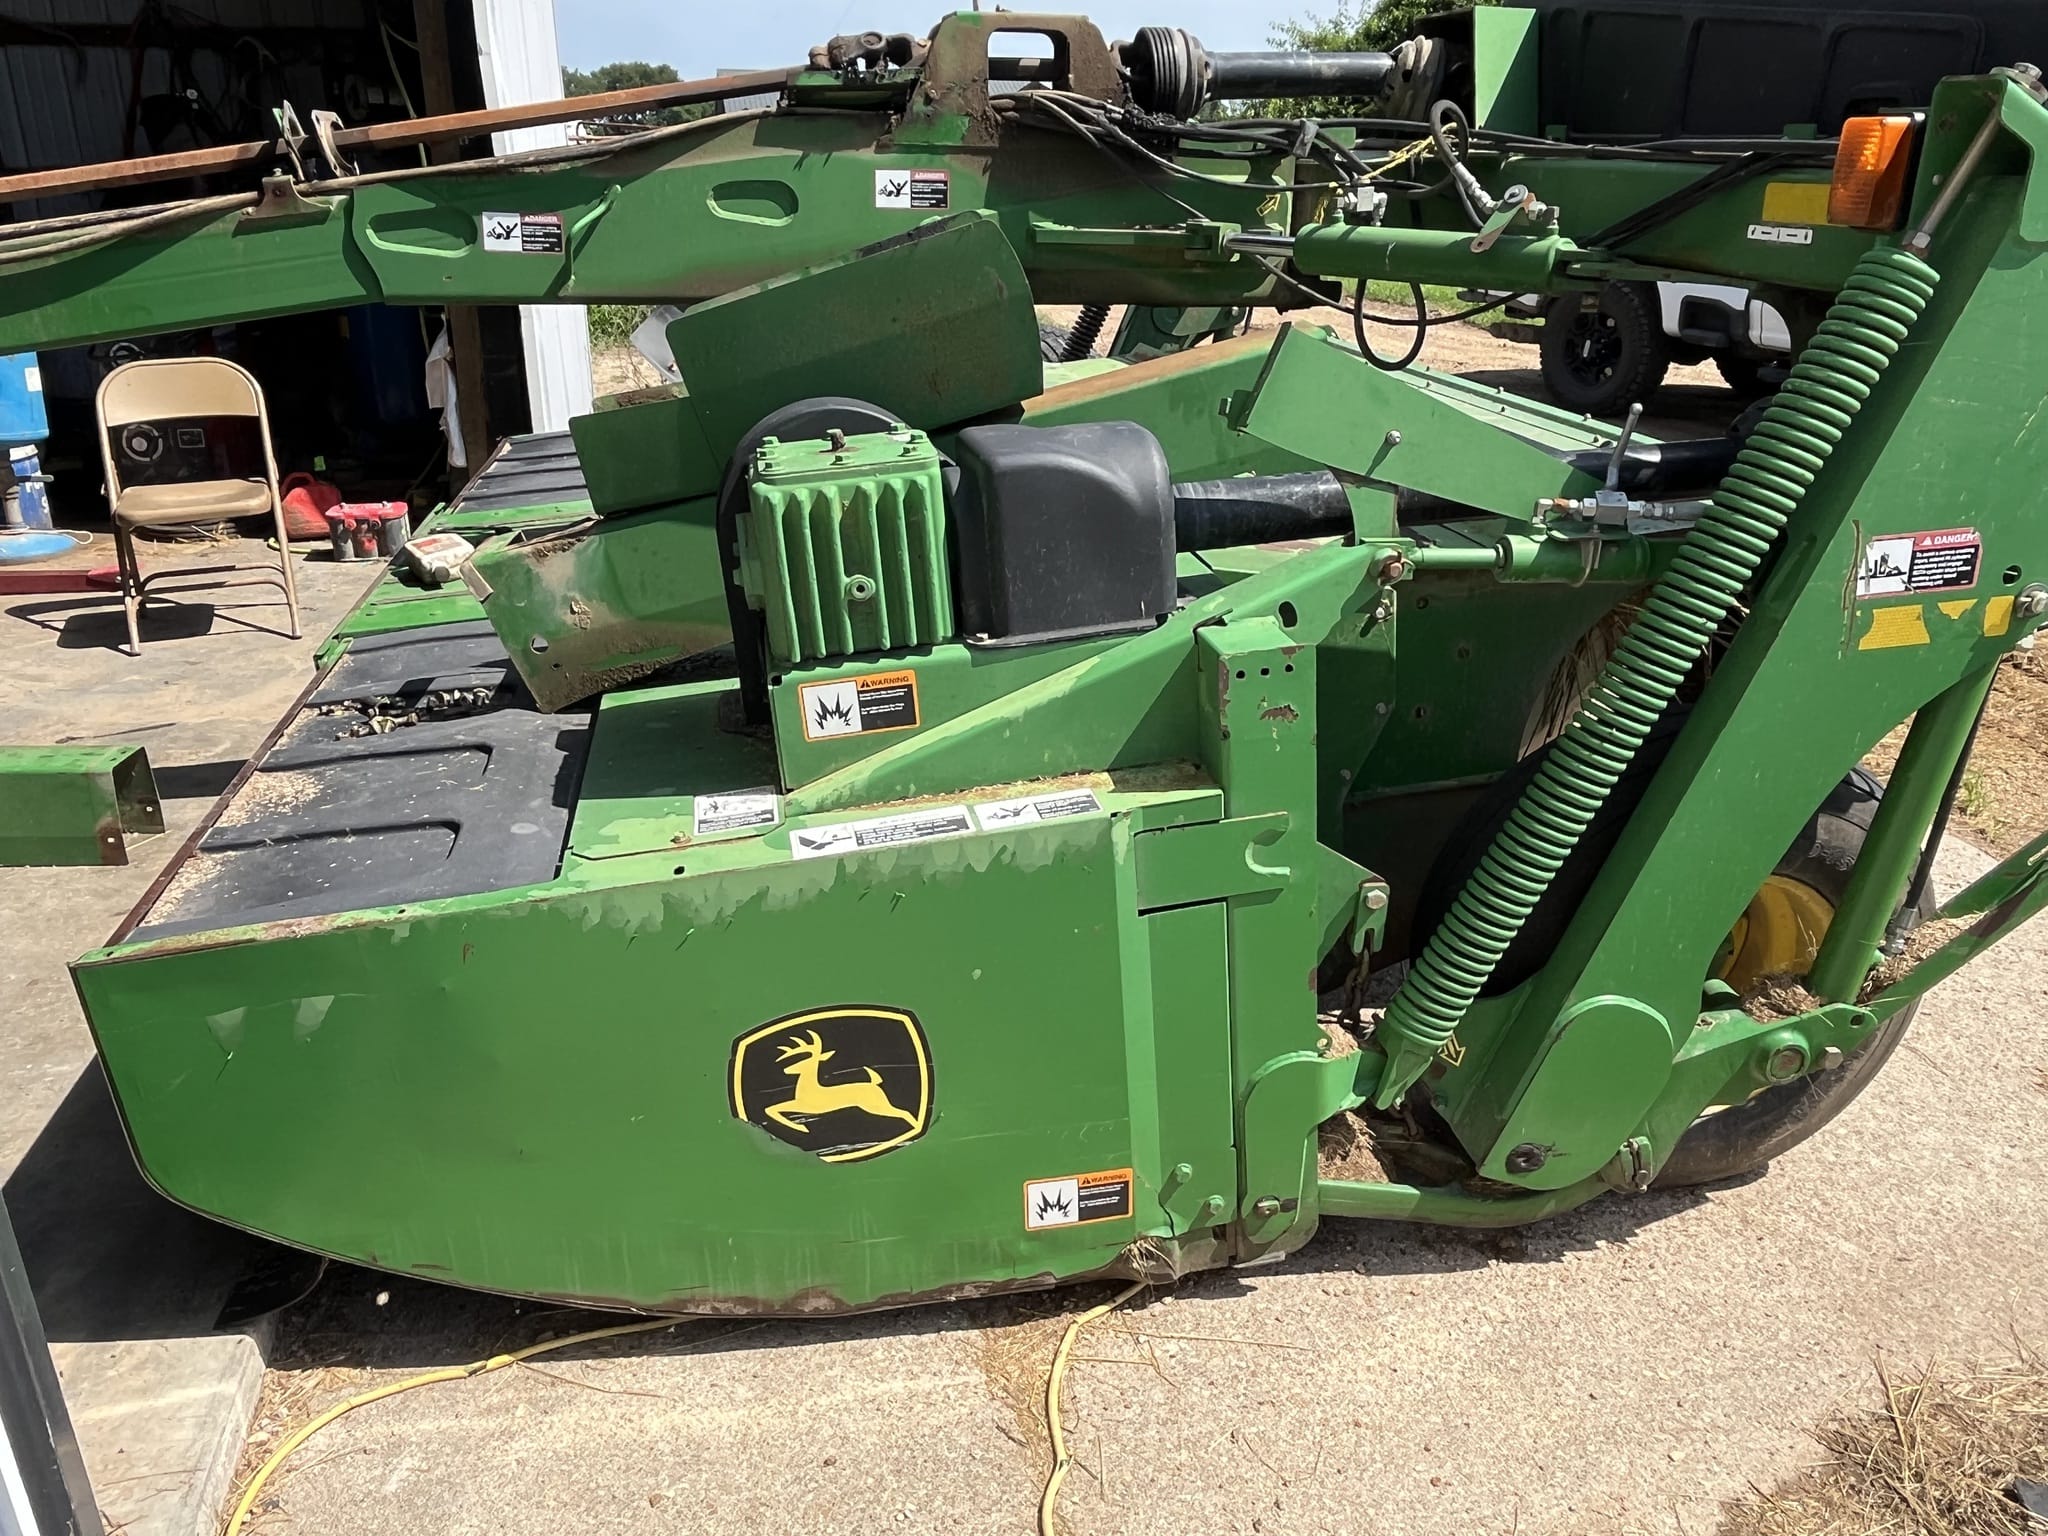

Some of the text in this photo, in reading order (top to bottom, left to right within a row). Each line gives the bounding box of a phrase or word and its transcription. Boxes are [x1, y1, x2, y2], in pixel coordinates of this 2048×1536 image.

[1934, 533, 1974, 545] DANGER
[870, 676, 909, 686] WARNING
[1091, 1173, 1127, 1183] WARNING
